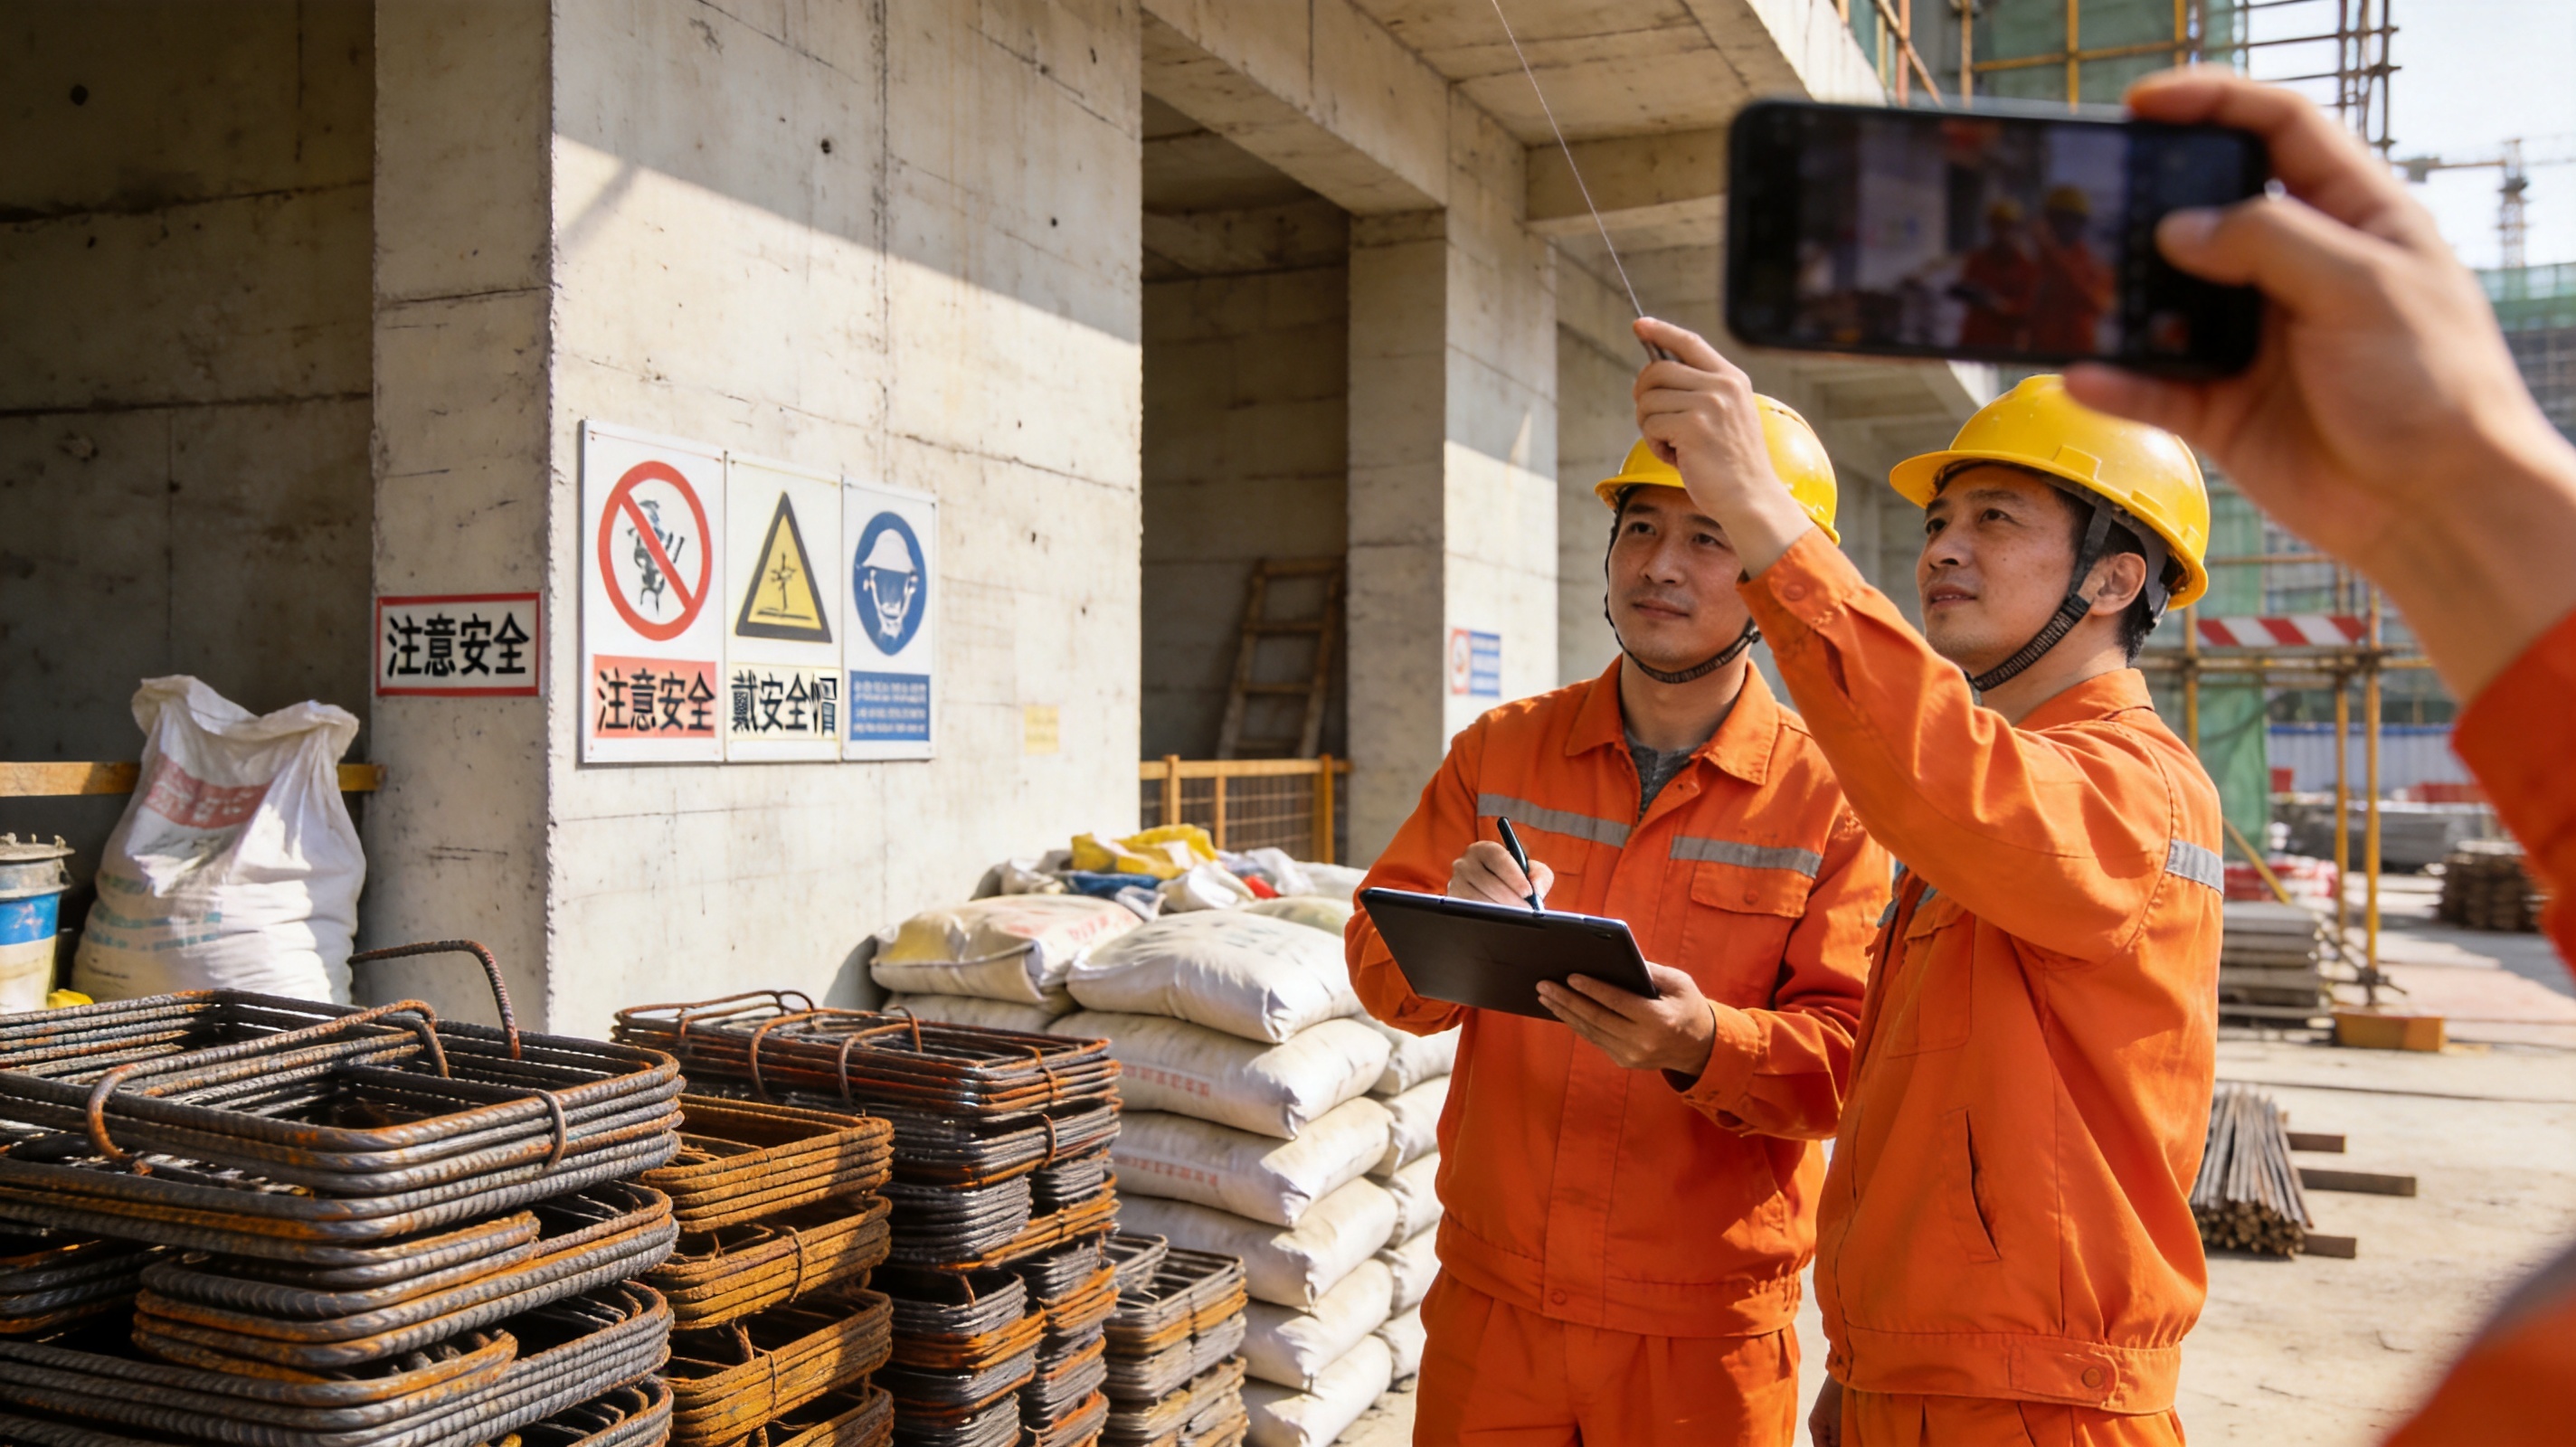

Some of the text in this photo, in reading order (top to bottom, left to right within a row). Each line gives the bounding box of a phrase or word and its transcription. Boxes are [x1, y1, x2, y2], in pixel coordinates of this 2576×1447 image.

[387, 612, 530, 676] 注意安全
[597, 667, 715, 733] 注意安全
